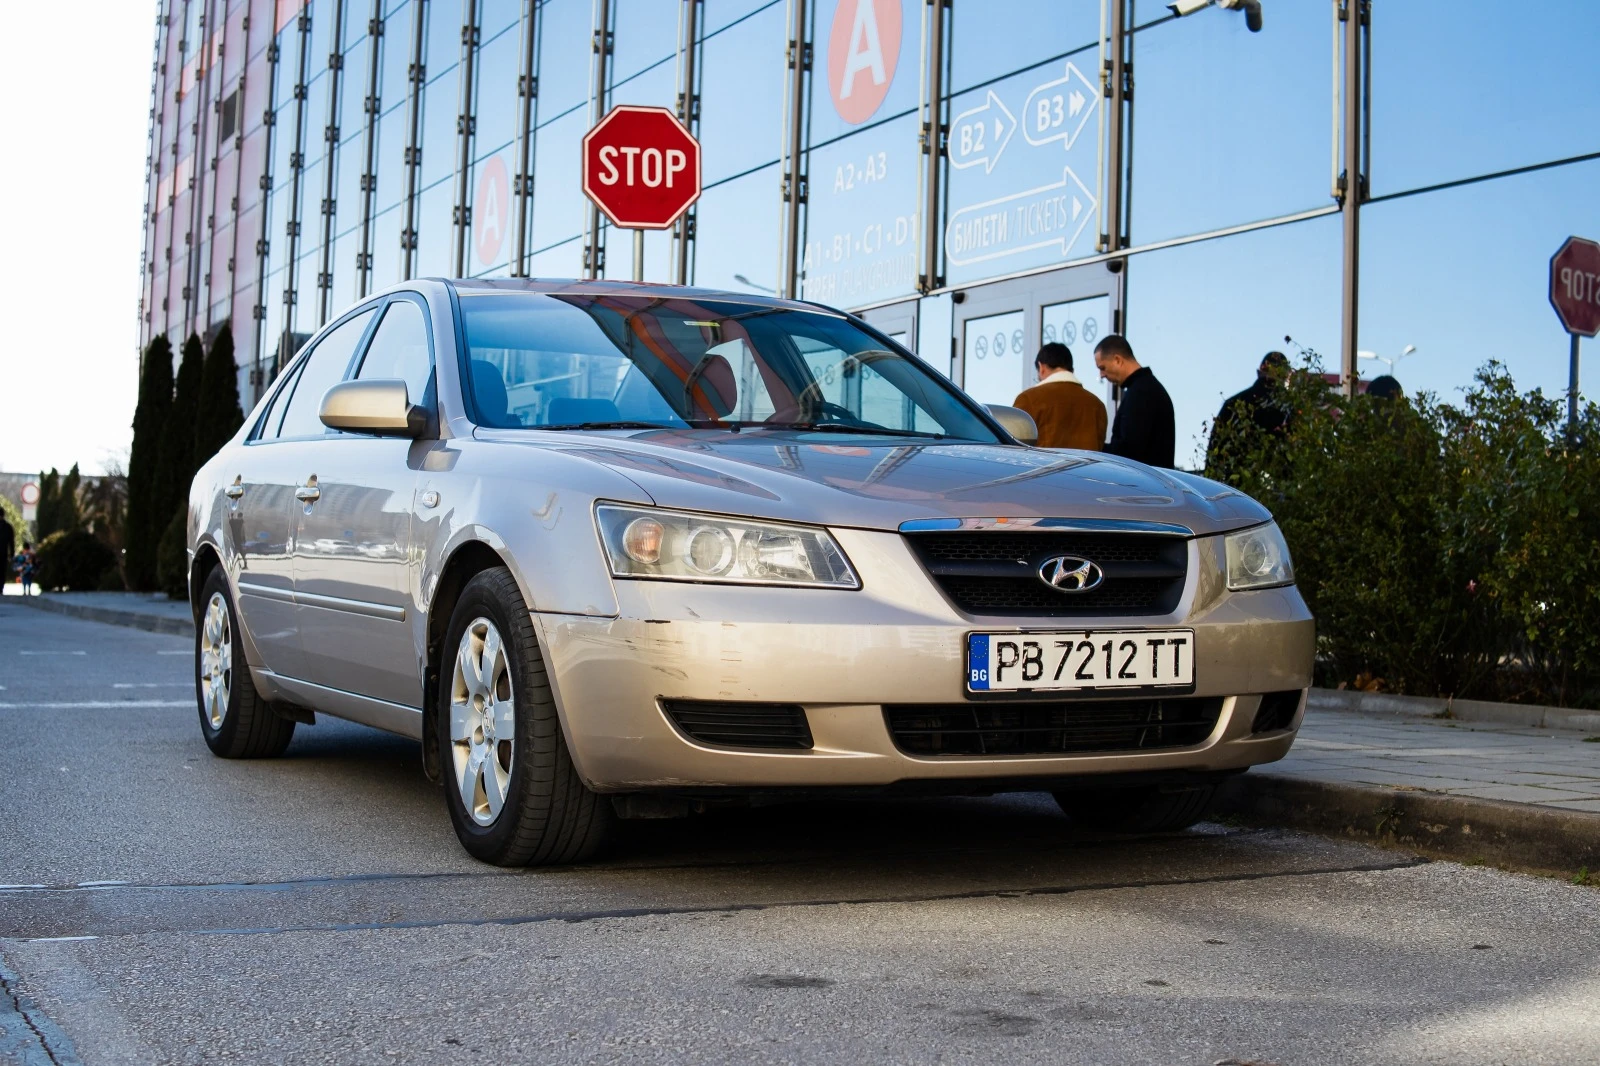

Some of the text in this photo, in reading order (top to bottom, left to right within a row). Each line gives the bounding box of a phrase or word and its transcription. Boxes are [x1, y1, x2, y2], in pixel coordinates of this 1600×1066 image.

[839, 0, 887, 101] A
[1036, 94, 1065, 133] B3
[960, 121, 985, 157] B2
[598, 145, 686, 188] STOP
[479, 175, 501, 248] A
[971, 669, 987, 682] BG
[996, 638, 1187, 682] PB 7212 TT
